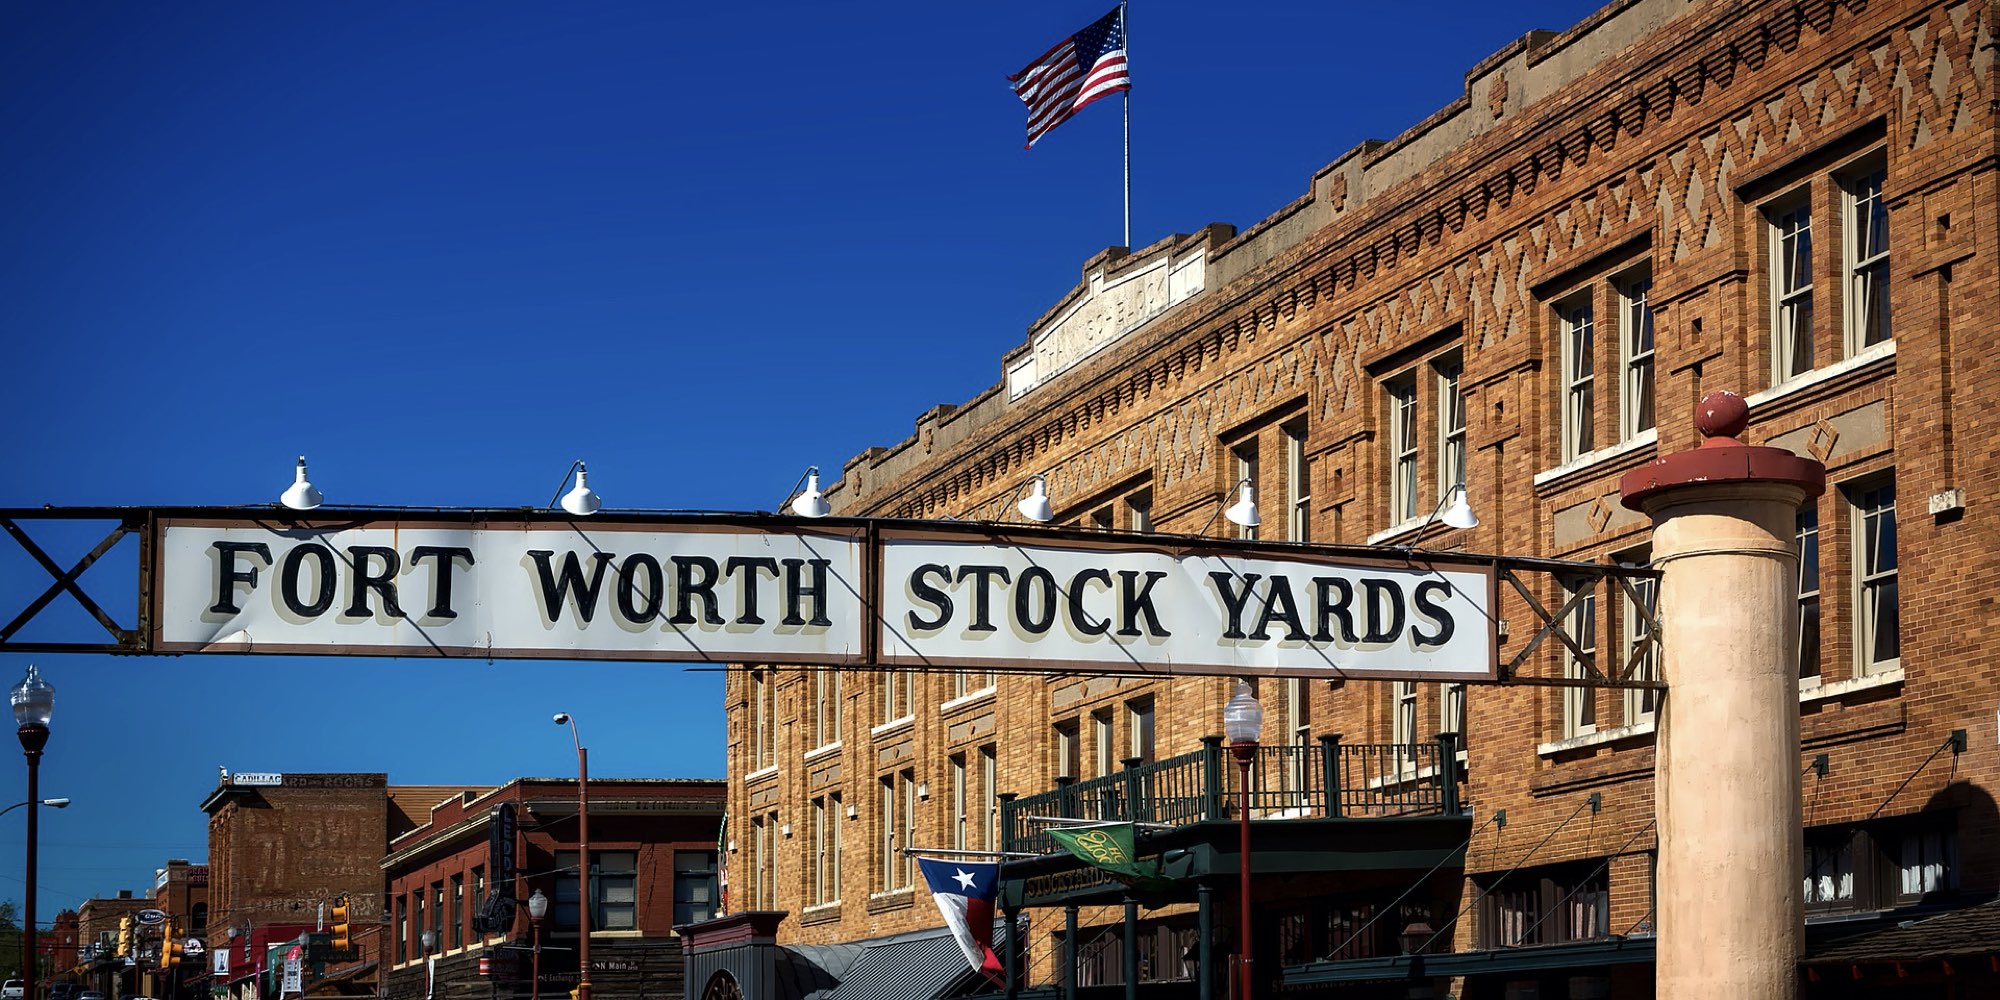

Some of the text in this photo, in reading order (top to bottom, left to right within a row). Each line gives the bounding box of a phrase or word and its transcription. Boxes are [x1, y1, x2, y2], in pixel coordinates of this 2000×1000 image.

[204, 541, 832, 628] FORT WORTH
[906, 563, 1454, 648] STOCK YARDS
[234, 775, 281, 784] CADILLAC
[1026, 866, 1112, 898] STOCKYARDS
[609, 961, 627, 971] Main
